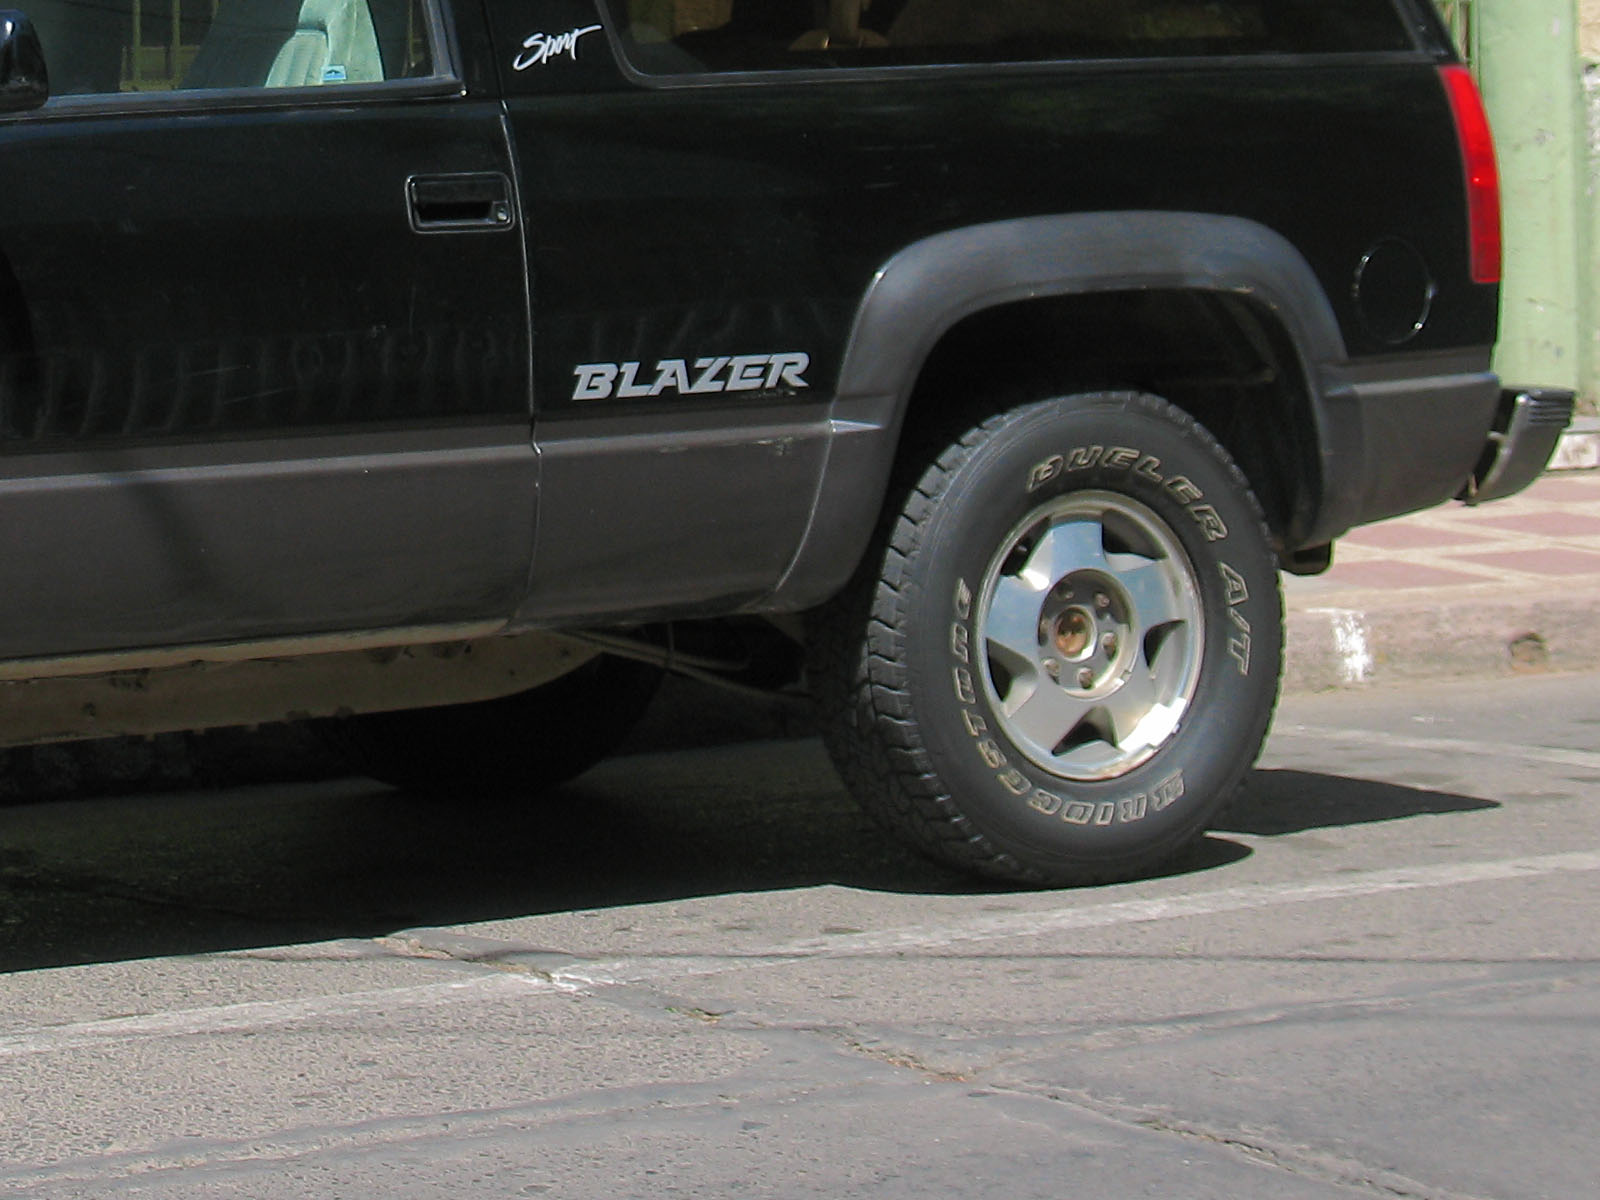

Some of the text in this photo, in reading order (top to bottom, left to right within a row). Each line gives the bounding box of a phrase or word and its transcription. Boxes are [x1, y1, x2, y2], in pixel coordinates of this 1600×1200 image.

[512, 24, 602, 72] Sport
[572, 351, 810, 401] BLAZER
[1026, 445, 1252, 676] DUELER A/T
[950, 577, 1186, 826] BRIDGESTONE
